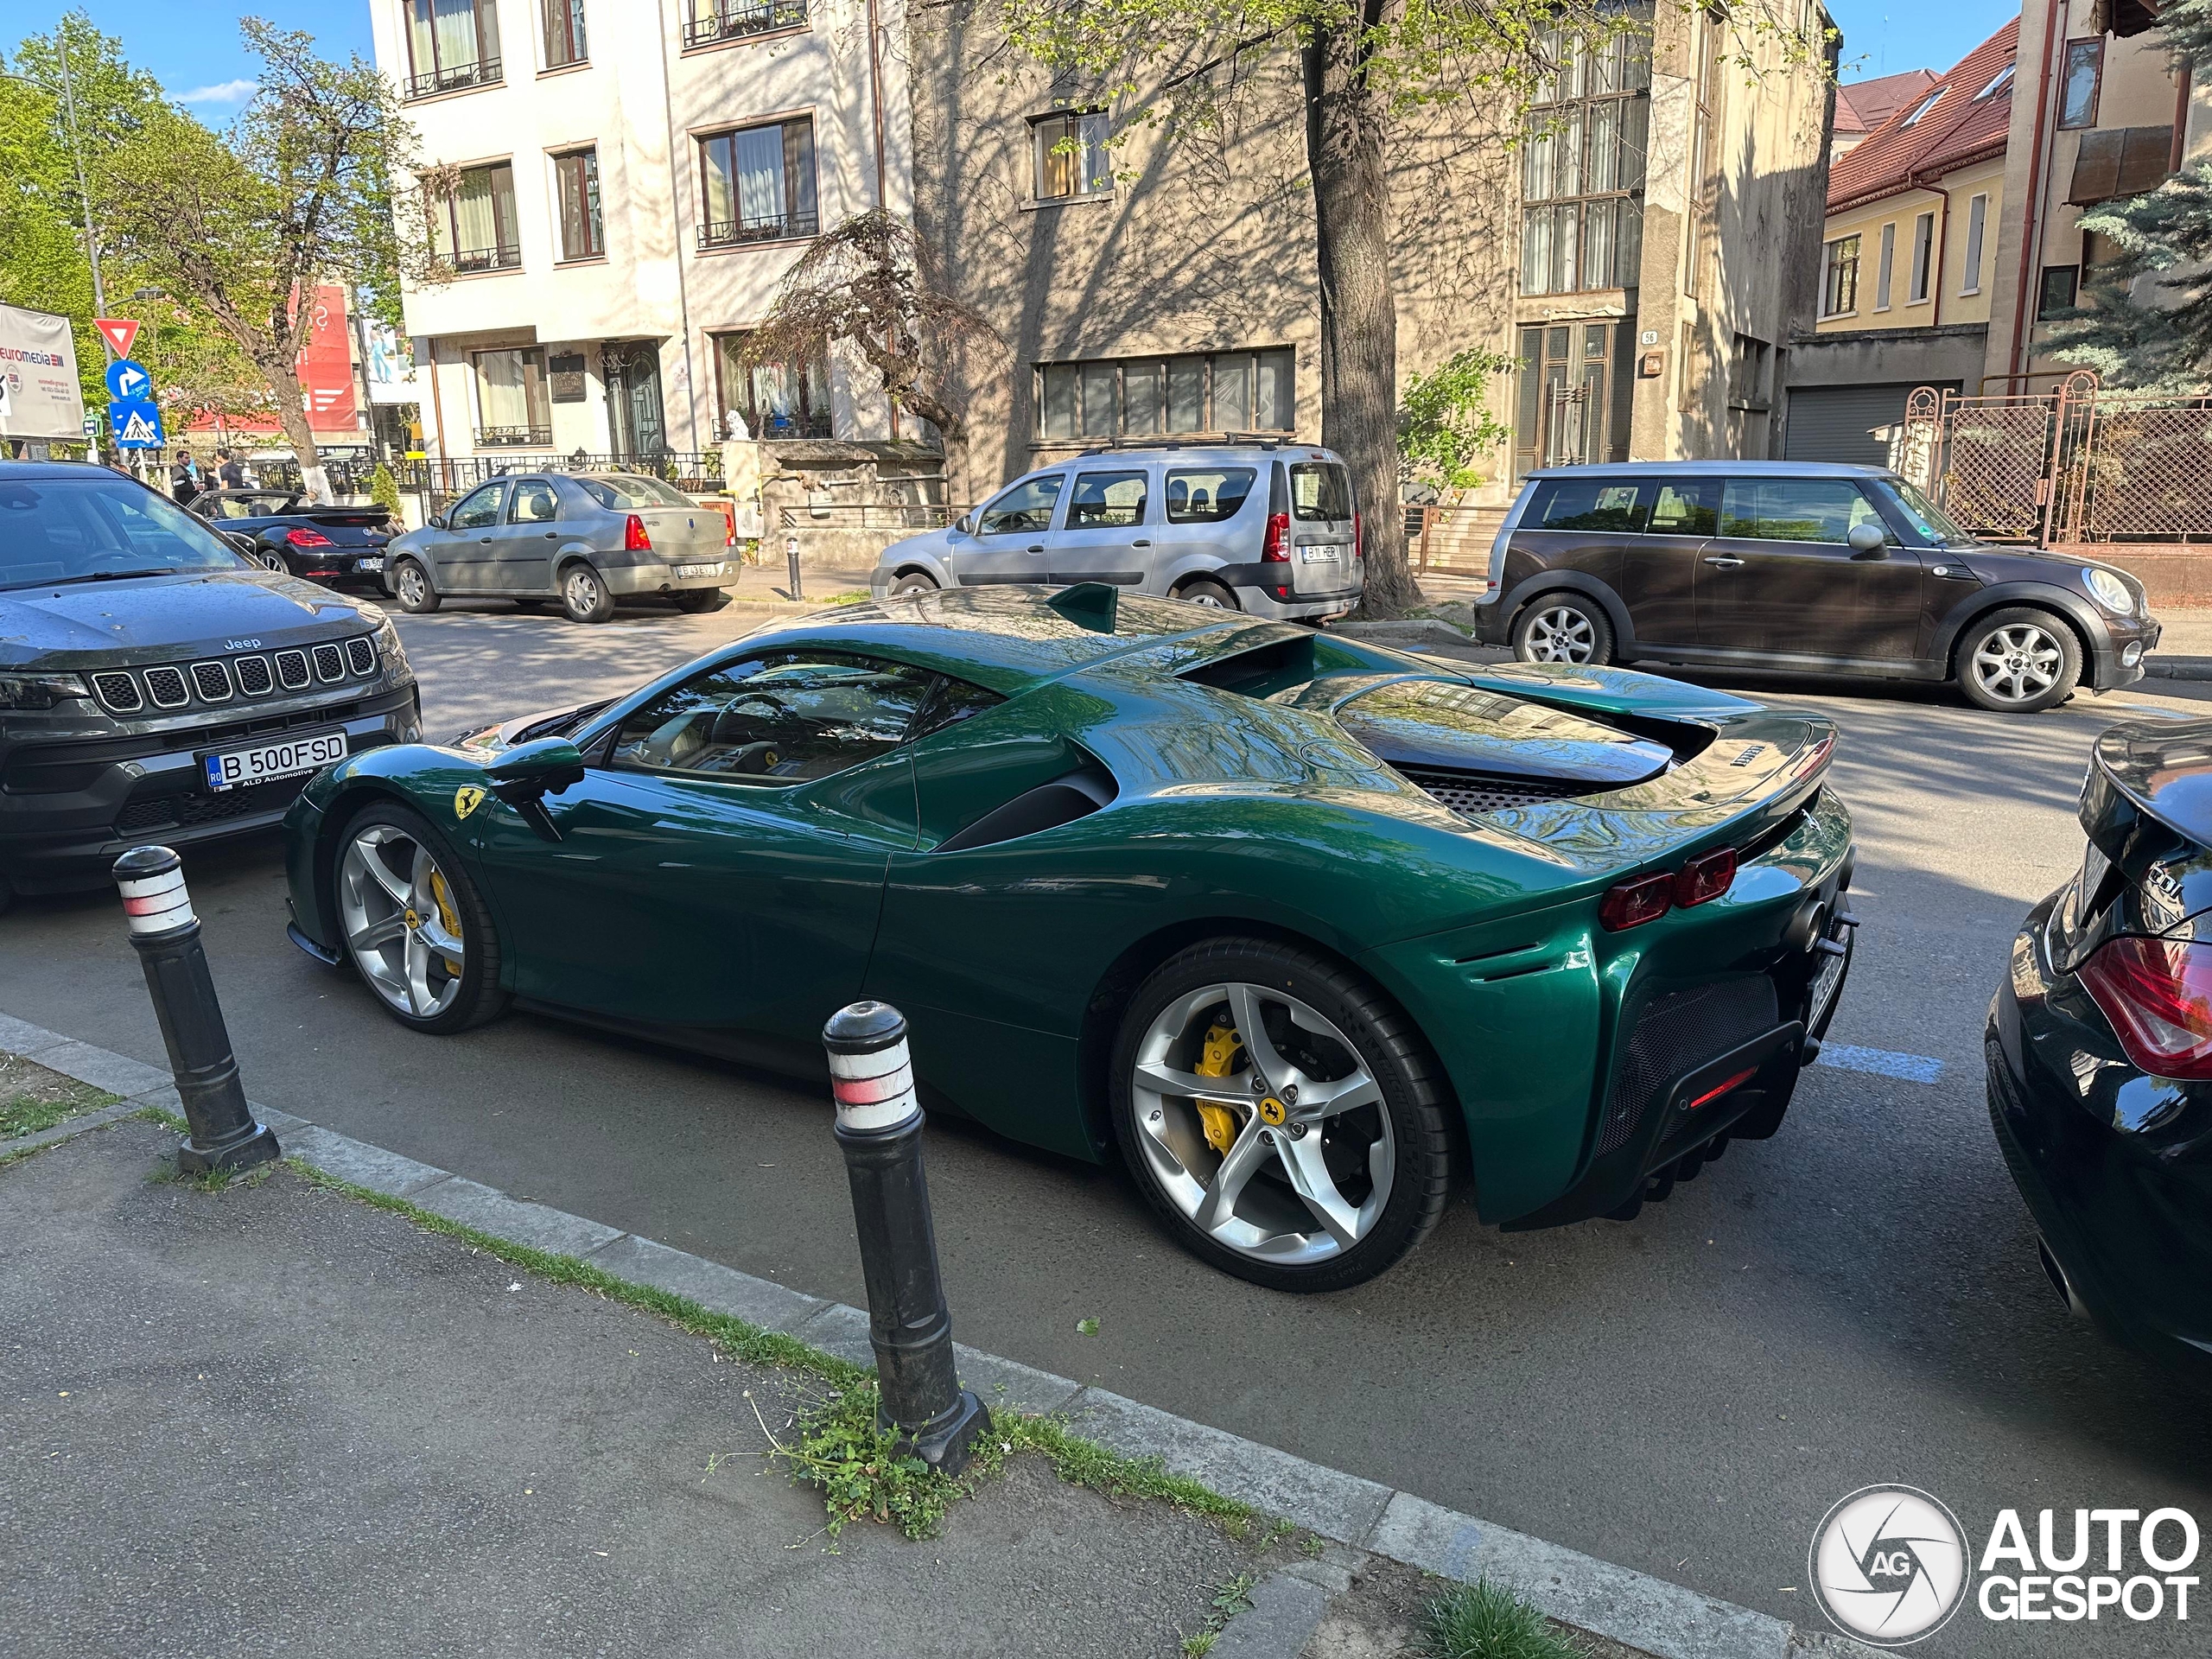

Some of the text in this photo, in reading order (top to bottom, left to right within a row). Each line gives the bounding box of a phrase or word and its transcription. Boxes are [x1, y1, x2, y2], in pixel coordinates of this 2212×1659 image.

[1645, 333, 1654, 342] 56
[1308, 546, 1337, 558] B 11 HER
[683, 566, 689, 575] B
[224, 637, 262, 651] Jeep
[223, 756, 242, 780] B
[210, 772, 222, 783] RO
[242, 768, 314, 787] ALD Automotive
